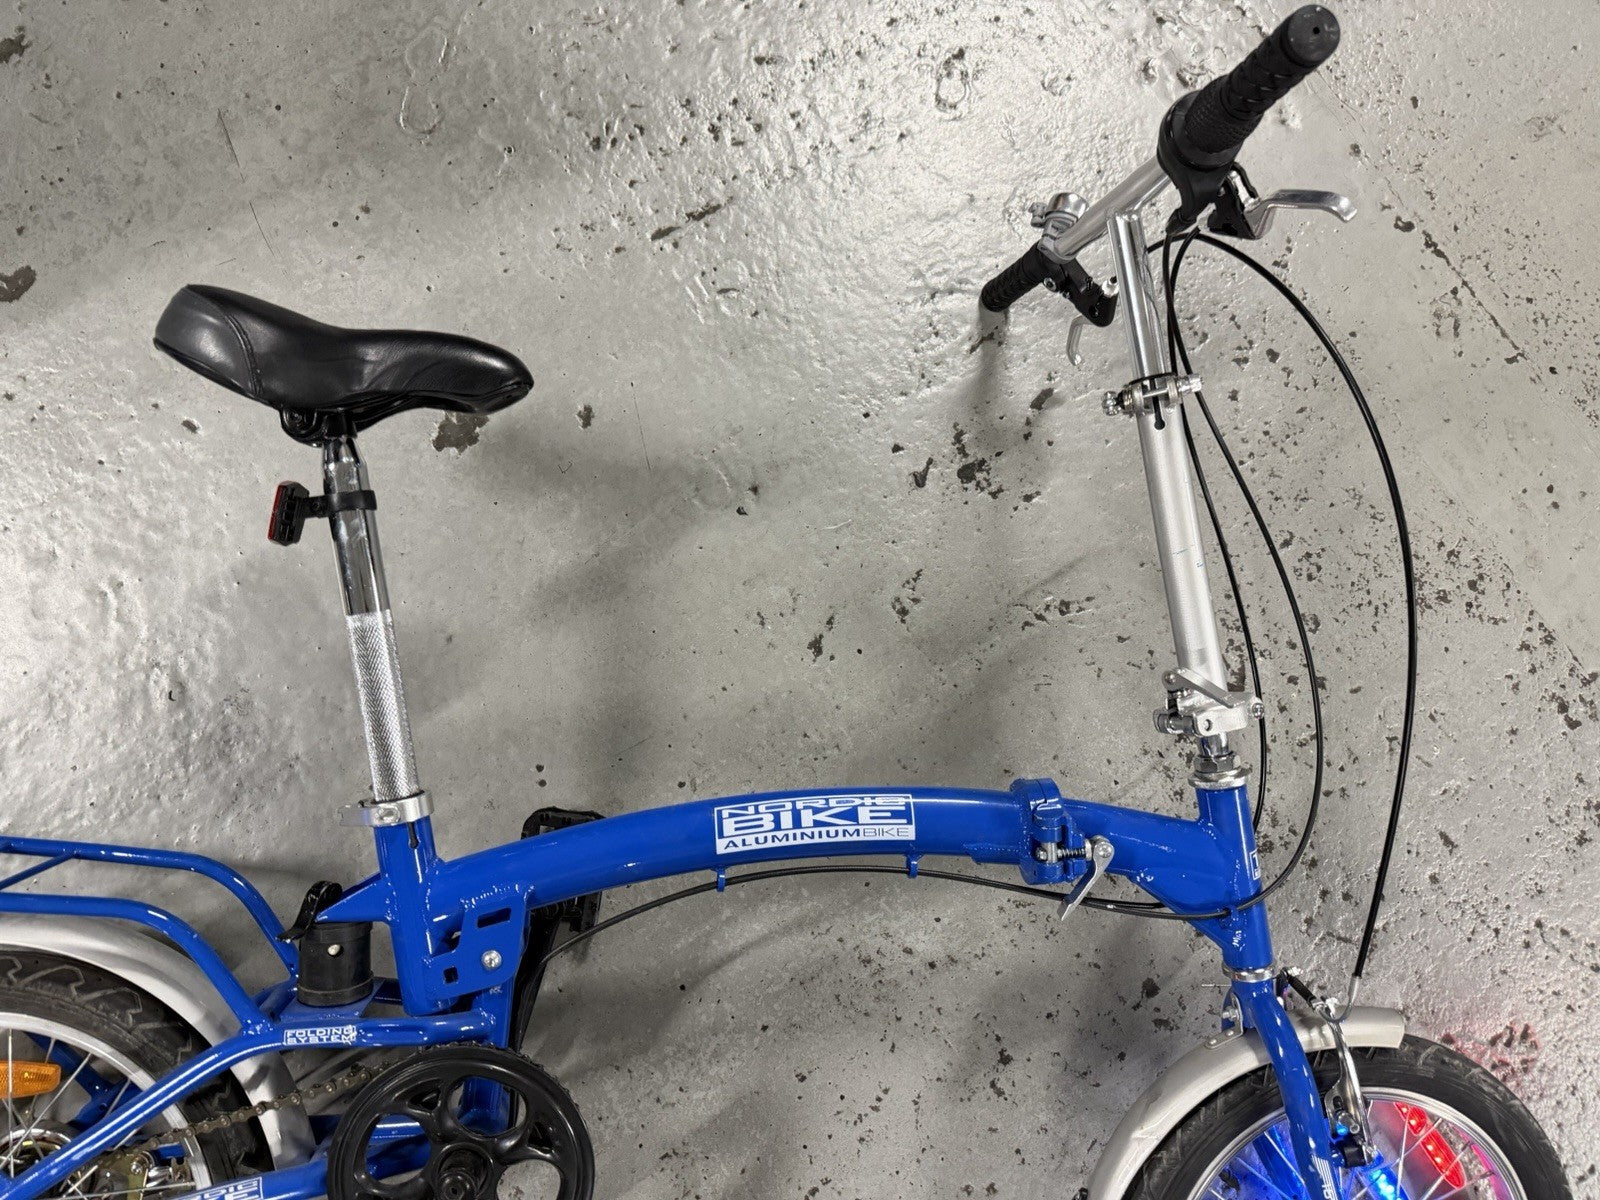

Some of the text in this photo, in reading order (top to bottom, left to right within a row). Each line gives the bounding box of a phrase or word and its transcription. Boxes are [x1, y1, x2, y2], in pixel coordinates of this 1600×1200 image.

[723, 806, 908, 837] BIKE
[286, 1025, 353, 1038] FOLDING
[287, 1034, 353, 1045] SYSTEM
